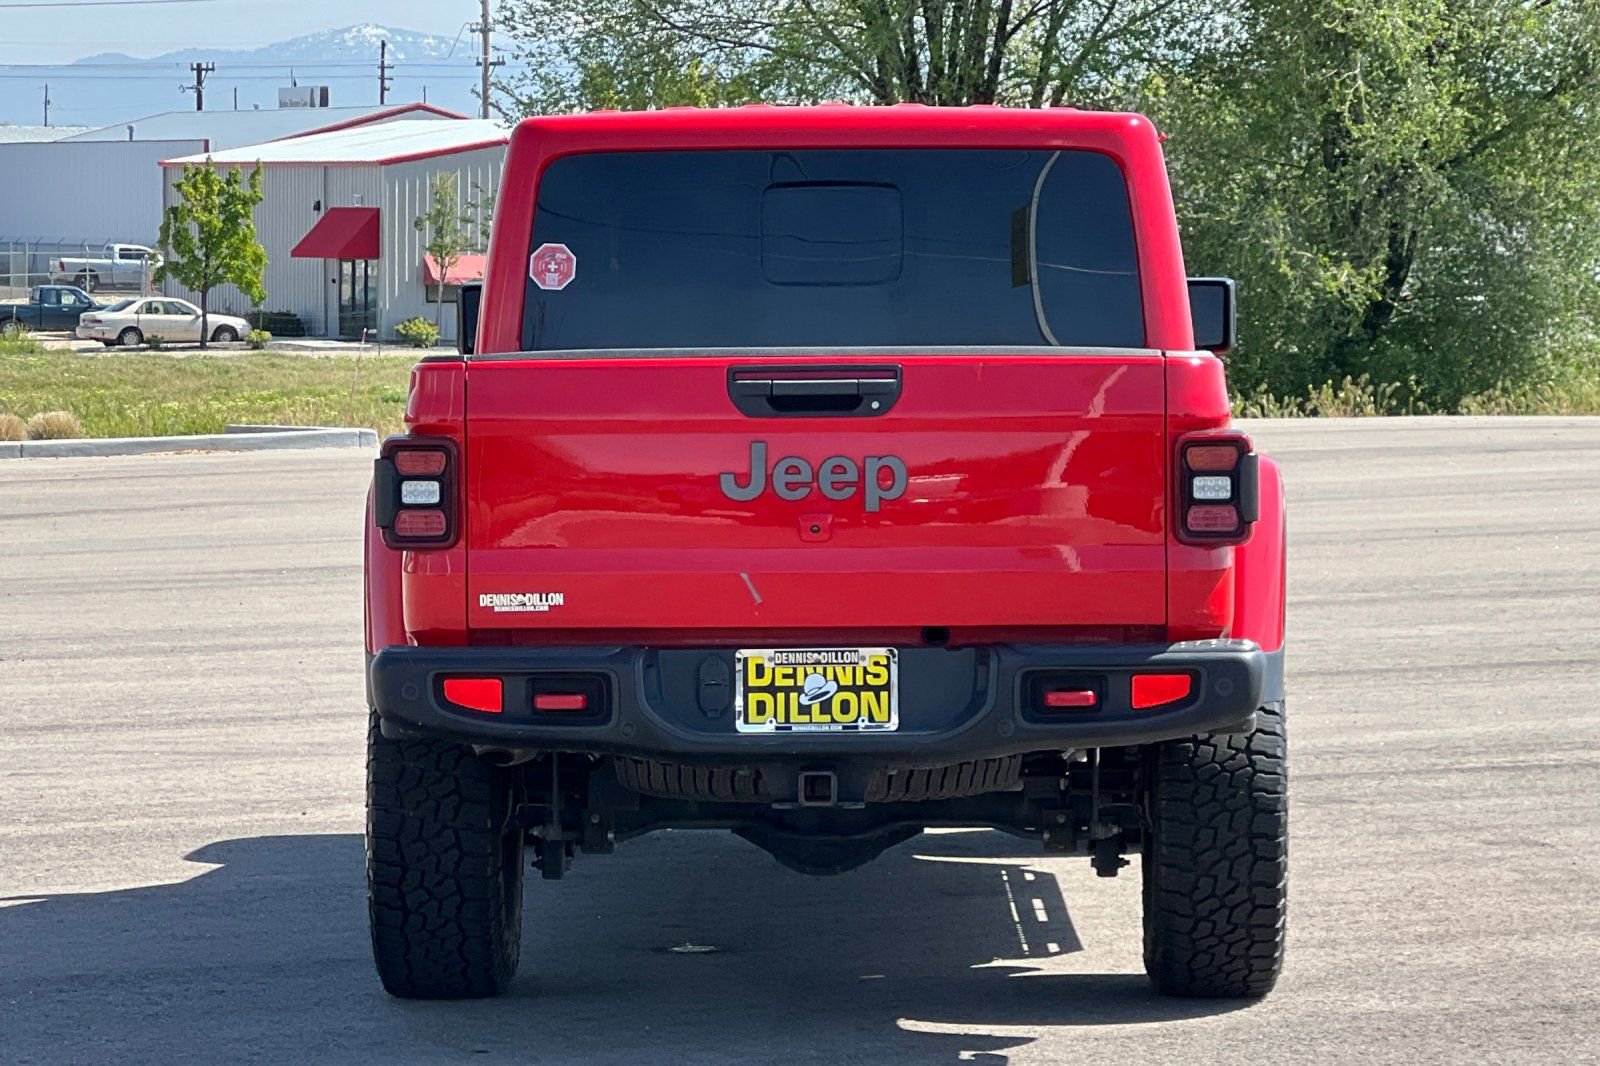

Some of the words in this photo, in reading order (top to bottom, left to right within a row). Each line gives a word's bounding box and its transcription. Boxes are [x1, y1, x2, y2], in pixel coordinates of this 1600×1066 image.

[720, 441, 908, 512] Jeep
[479, 593, 517, 607] DENNIS
[525, 592, 564, 606] DILLON
[775, 652, 816, 664] DENNIS
[820, 651, 858, 664] DILLON
[748, 691, 889, 723] DILLON
